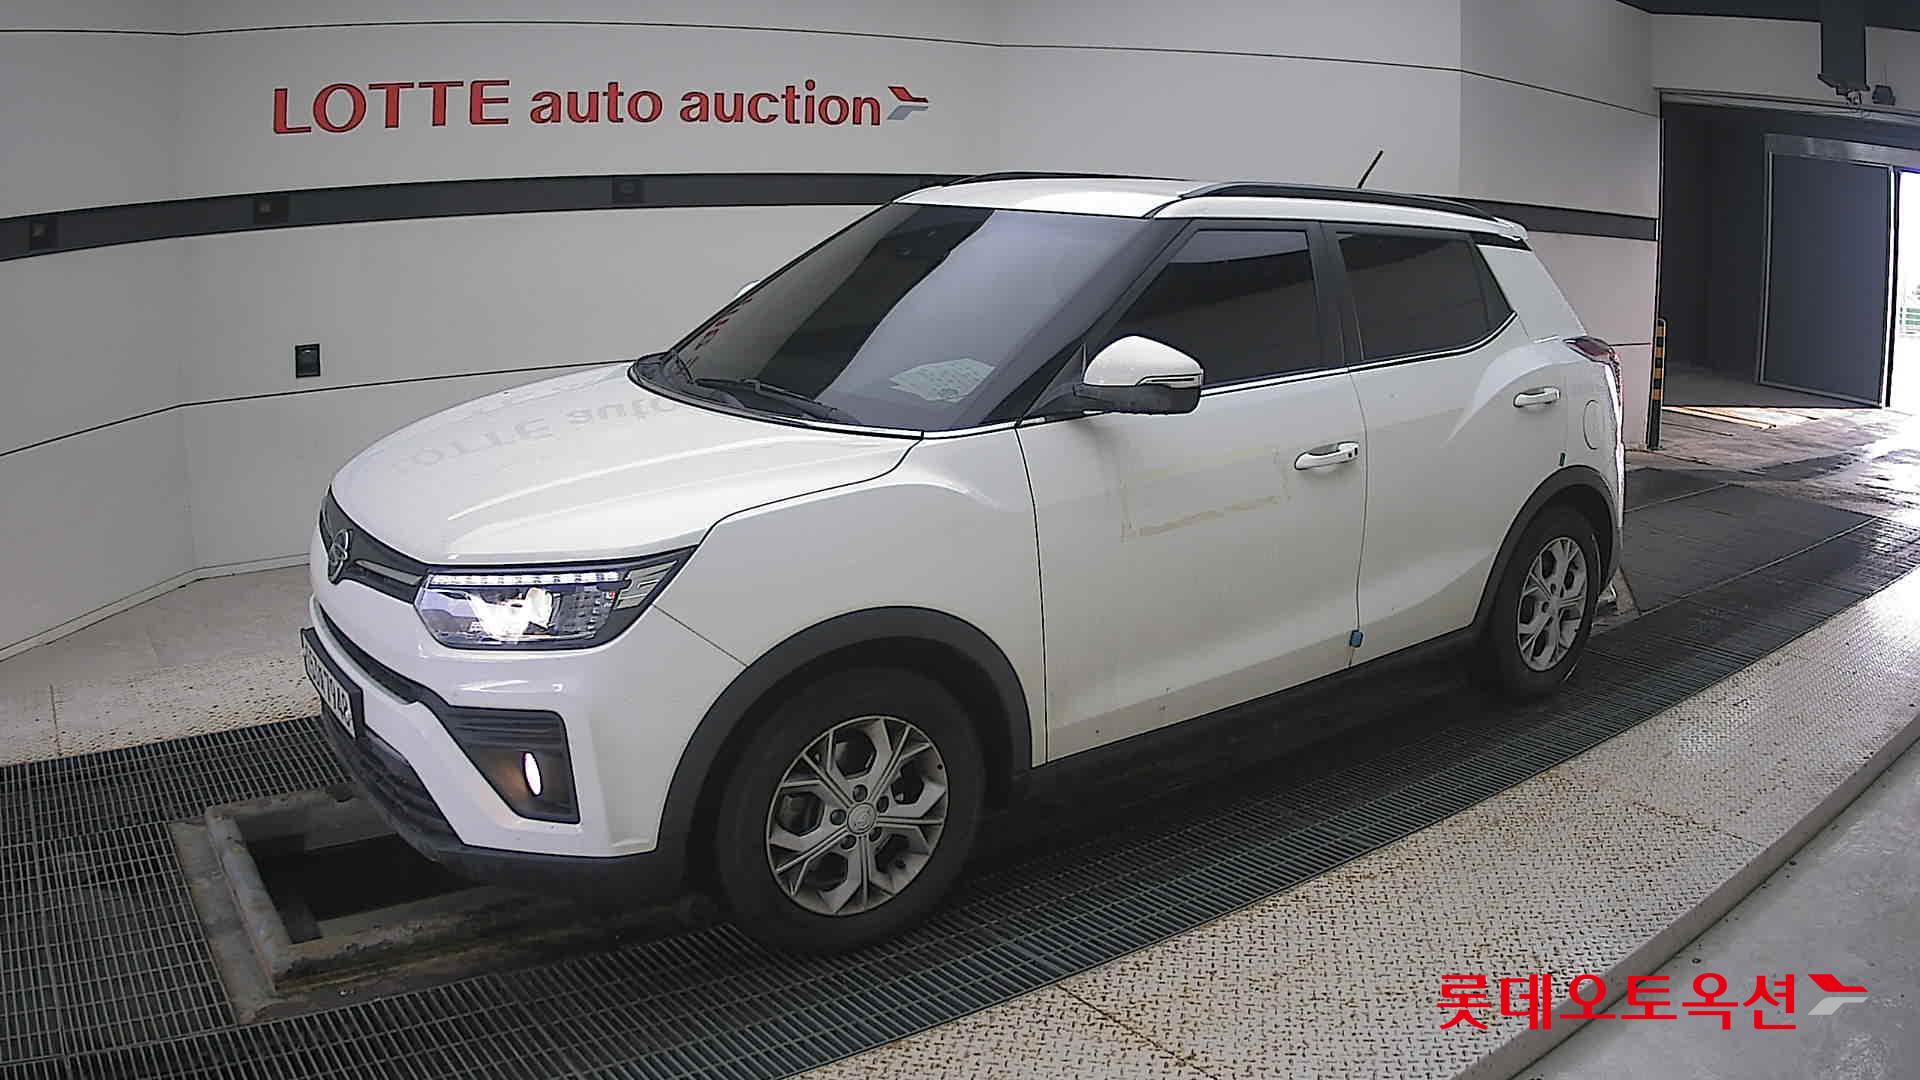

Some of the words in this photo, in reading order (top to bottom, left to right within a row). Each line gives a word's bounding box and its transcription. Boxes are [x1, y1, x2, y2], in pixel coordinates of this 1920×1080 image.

[273, 80, 510, 134] LOTTE
[530, 81, 663, 123] auto
[679, 79, 881, 125] auction
